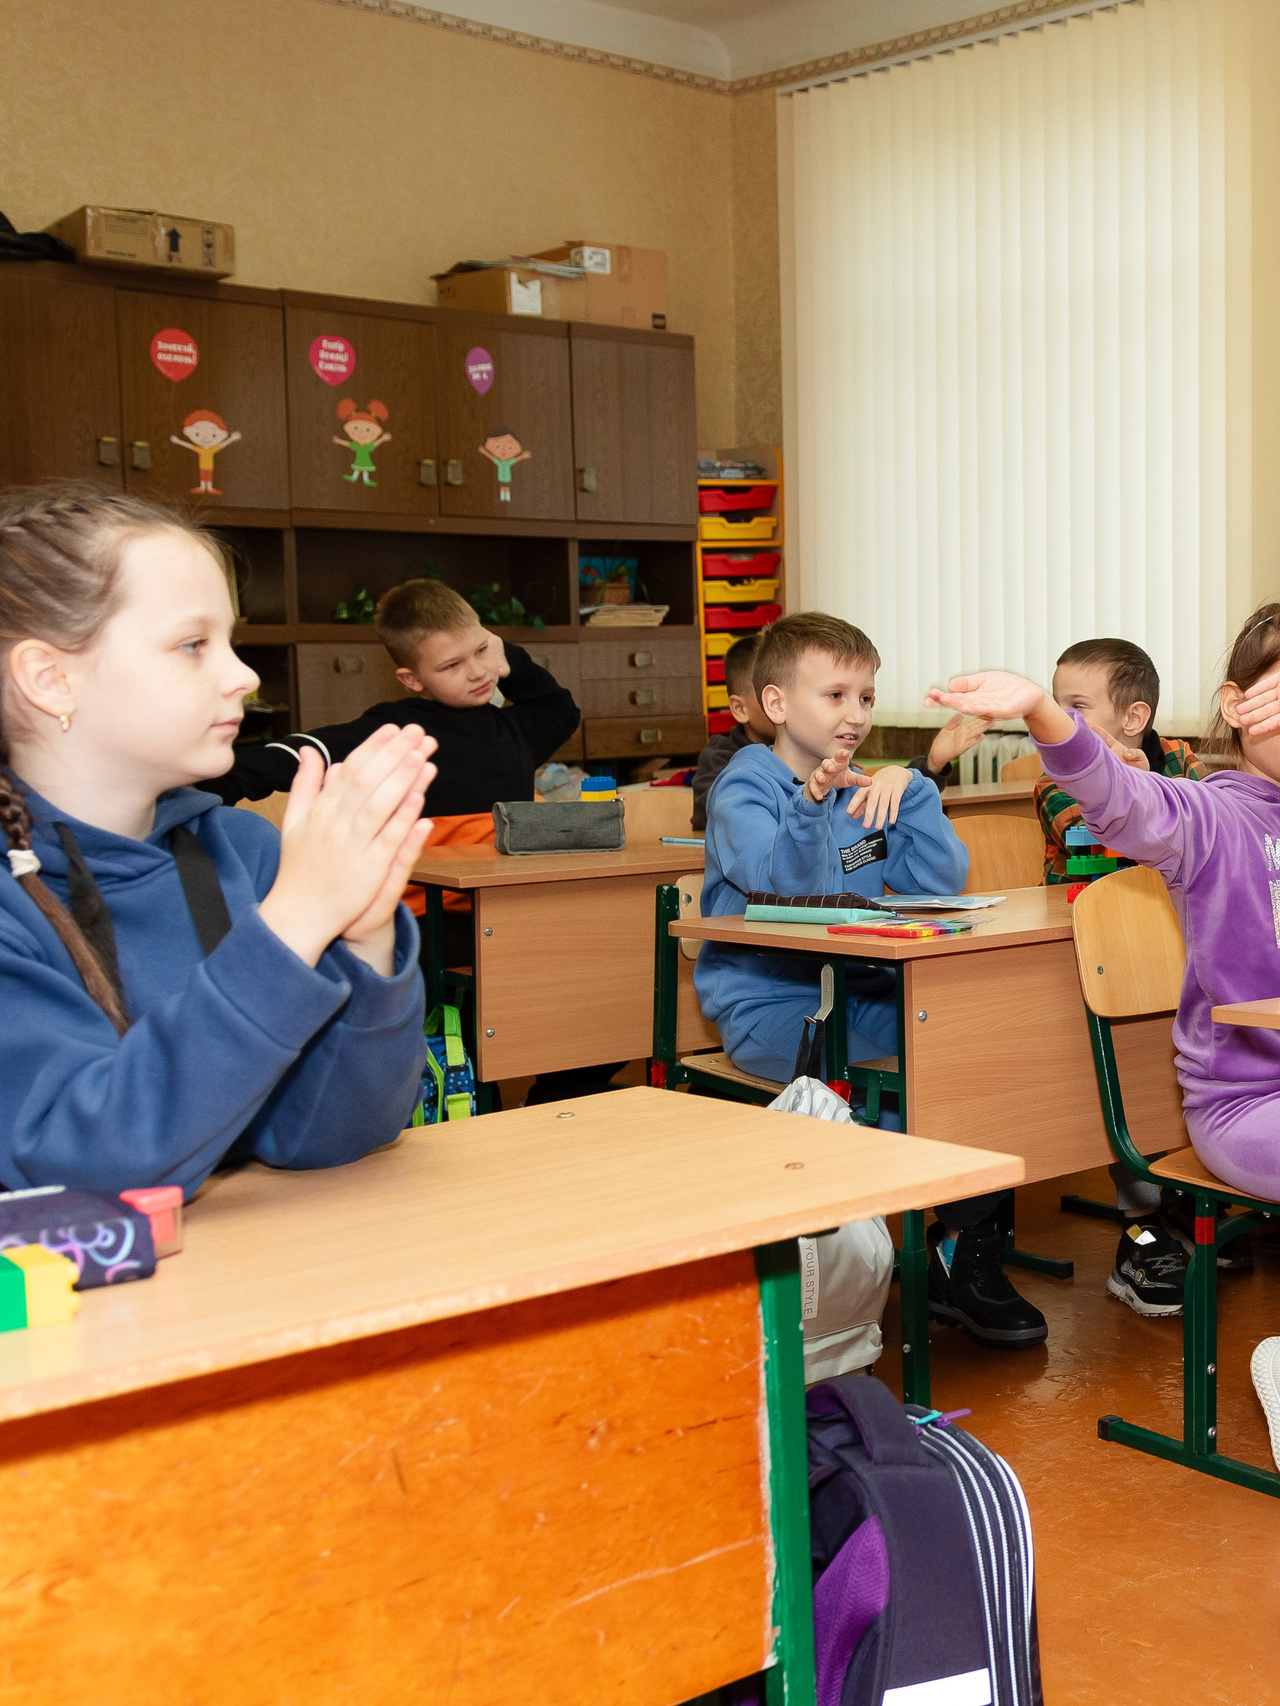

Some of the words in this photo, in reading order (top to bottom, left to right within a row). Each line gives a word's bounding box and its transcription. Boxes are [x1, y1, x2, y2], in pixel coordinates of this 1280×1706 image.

[851, 839, 867, 852] BRAND
[804, 1243, 815, 1277] YOUR
[803, 1280, 815, 1316] STYLE
